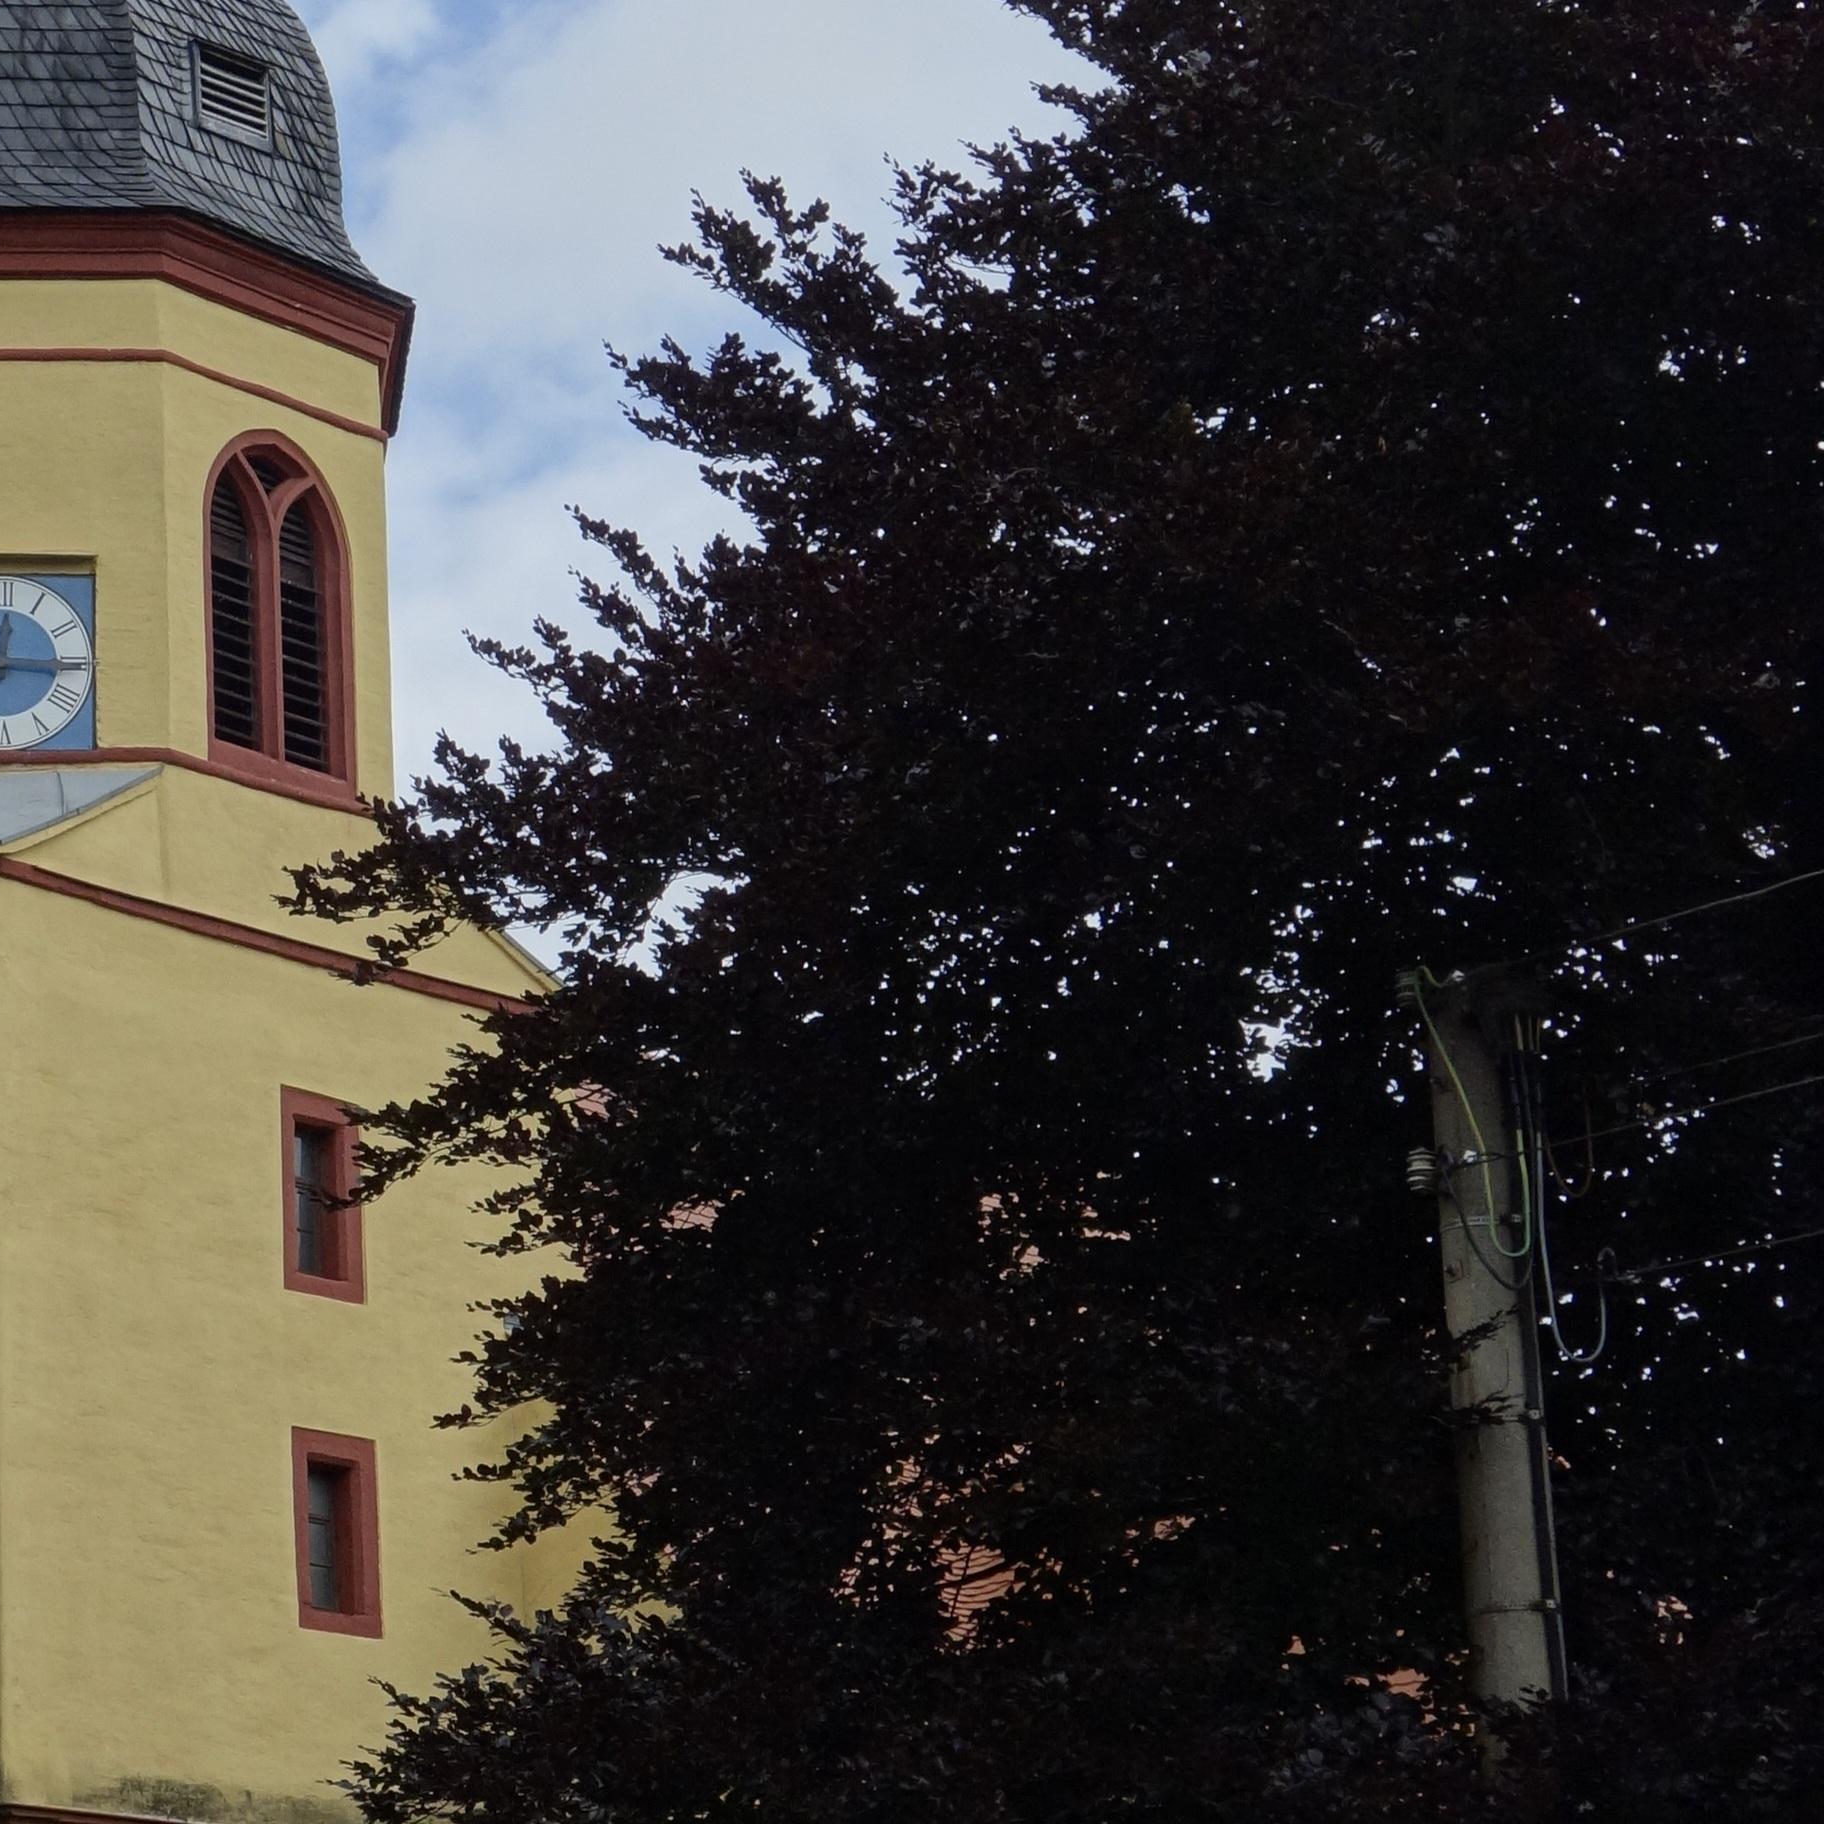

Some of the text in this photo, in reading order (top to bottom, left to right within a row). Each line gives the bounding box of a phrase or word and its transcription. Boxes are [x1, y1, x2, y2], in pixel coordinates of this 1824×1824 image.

[30, 592, 46, 614] I
[51, 620, 77, 638] II
[47, 683, 80, 714] IIII
[31, 712, 49, 736] V
